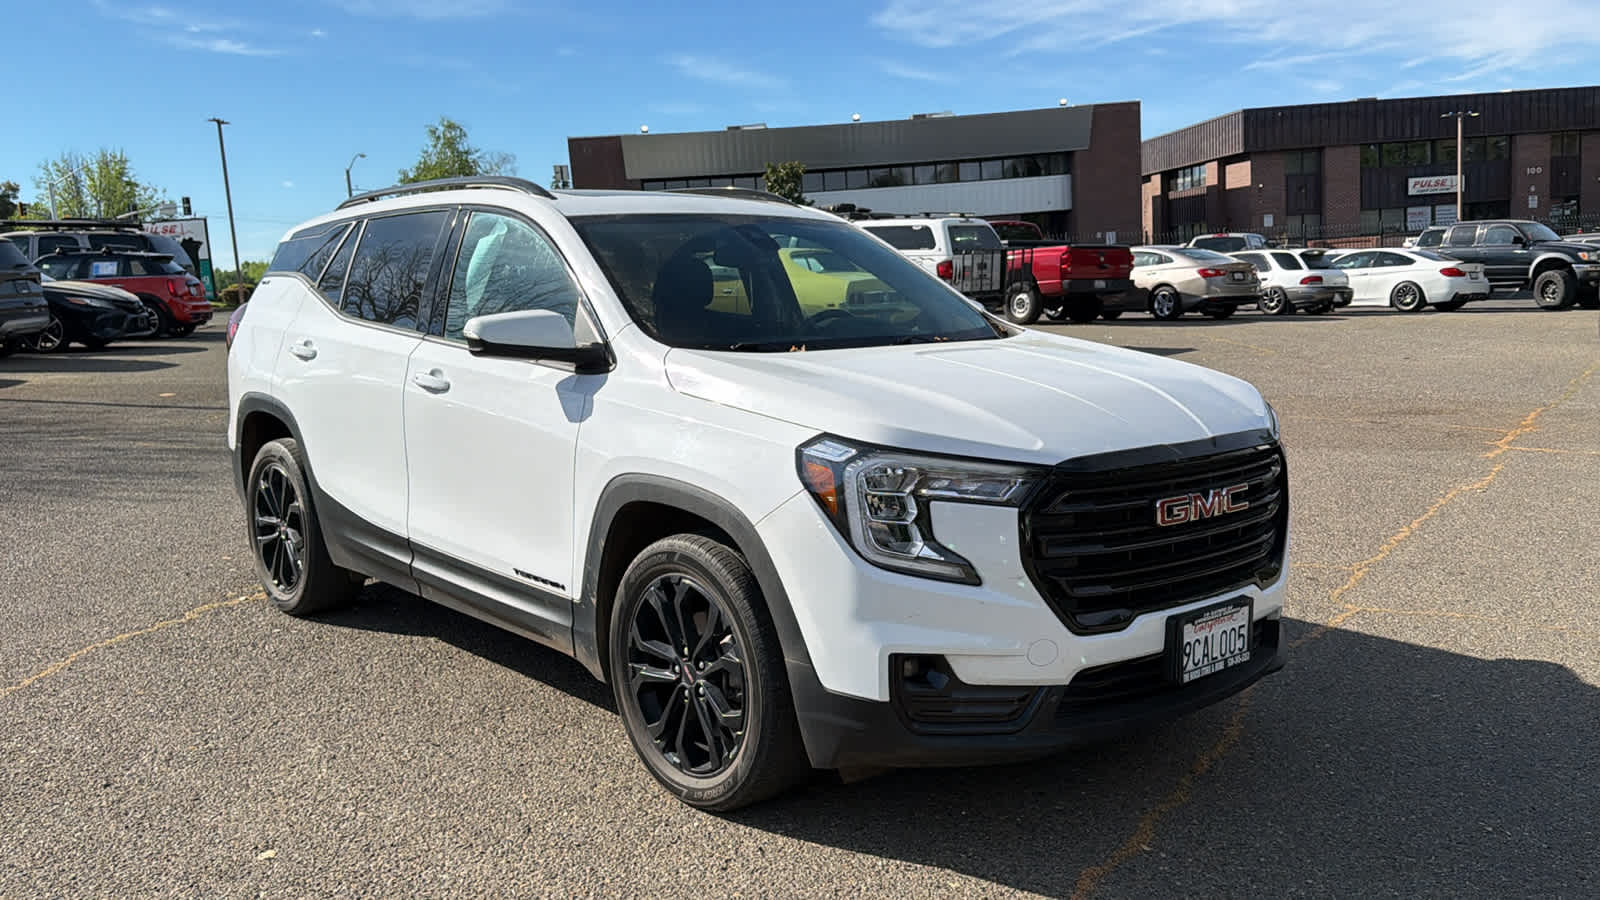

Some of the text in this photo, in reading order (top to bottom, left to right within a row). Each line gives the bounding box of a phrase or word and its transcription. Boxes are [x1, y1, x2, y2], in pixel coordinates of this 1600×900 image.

[1527, 166, 1543, 175] 100
[1412, 178, 1448, 189] PULSE
[144, 224, 176, 234] ULSE
[1155, 482, 1249, 527] GMC
[1183, 624, 1246, 671] 9CAL005
